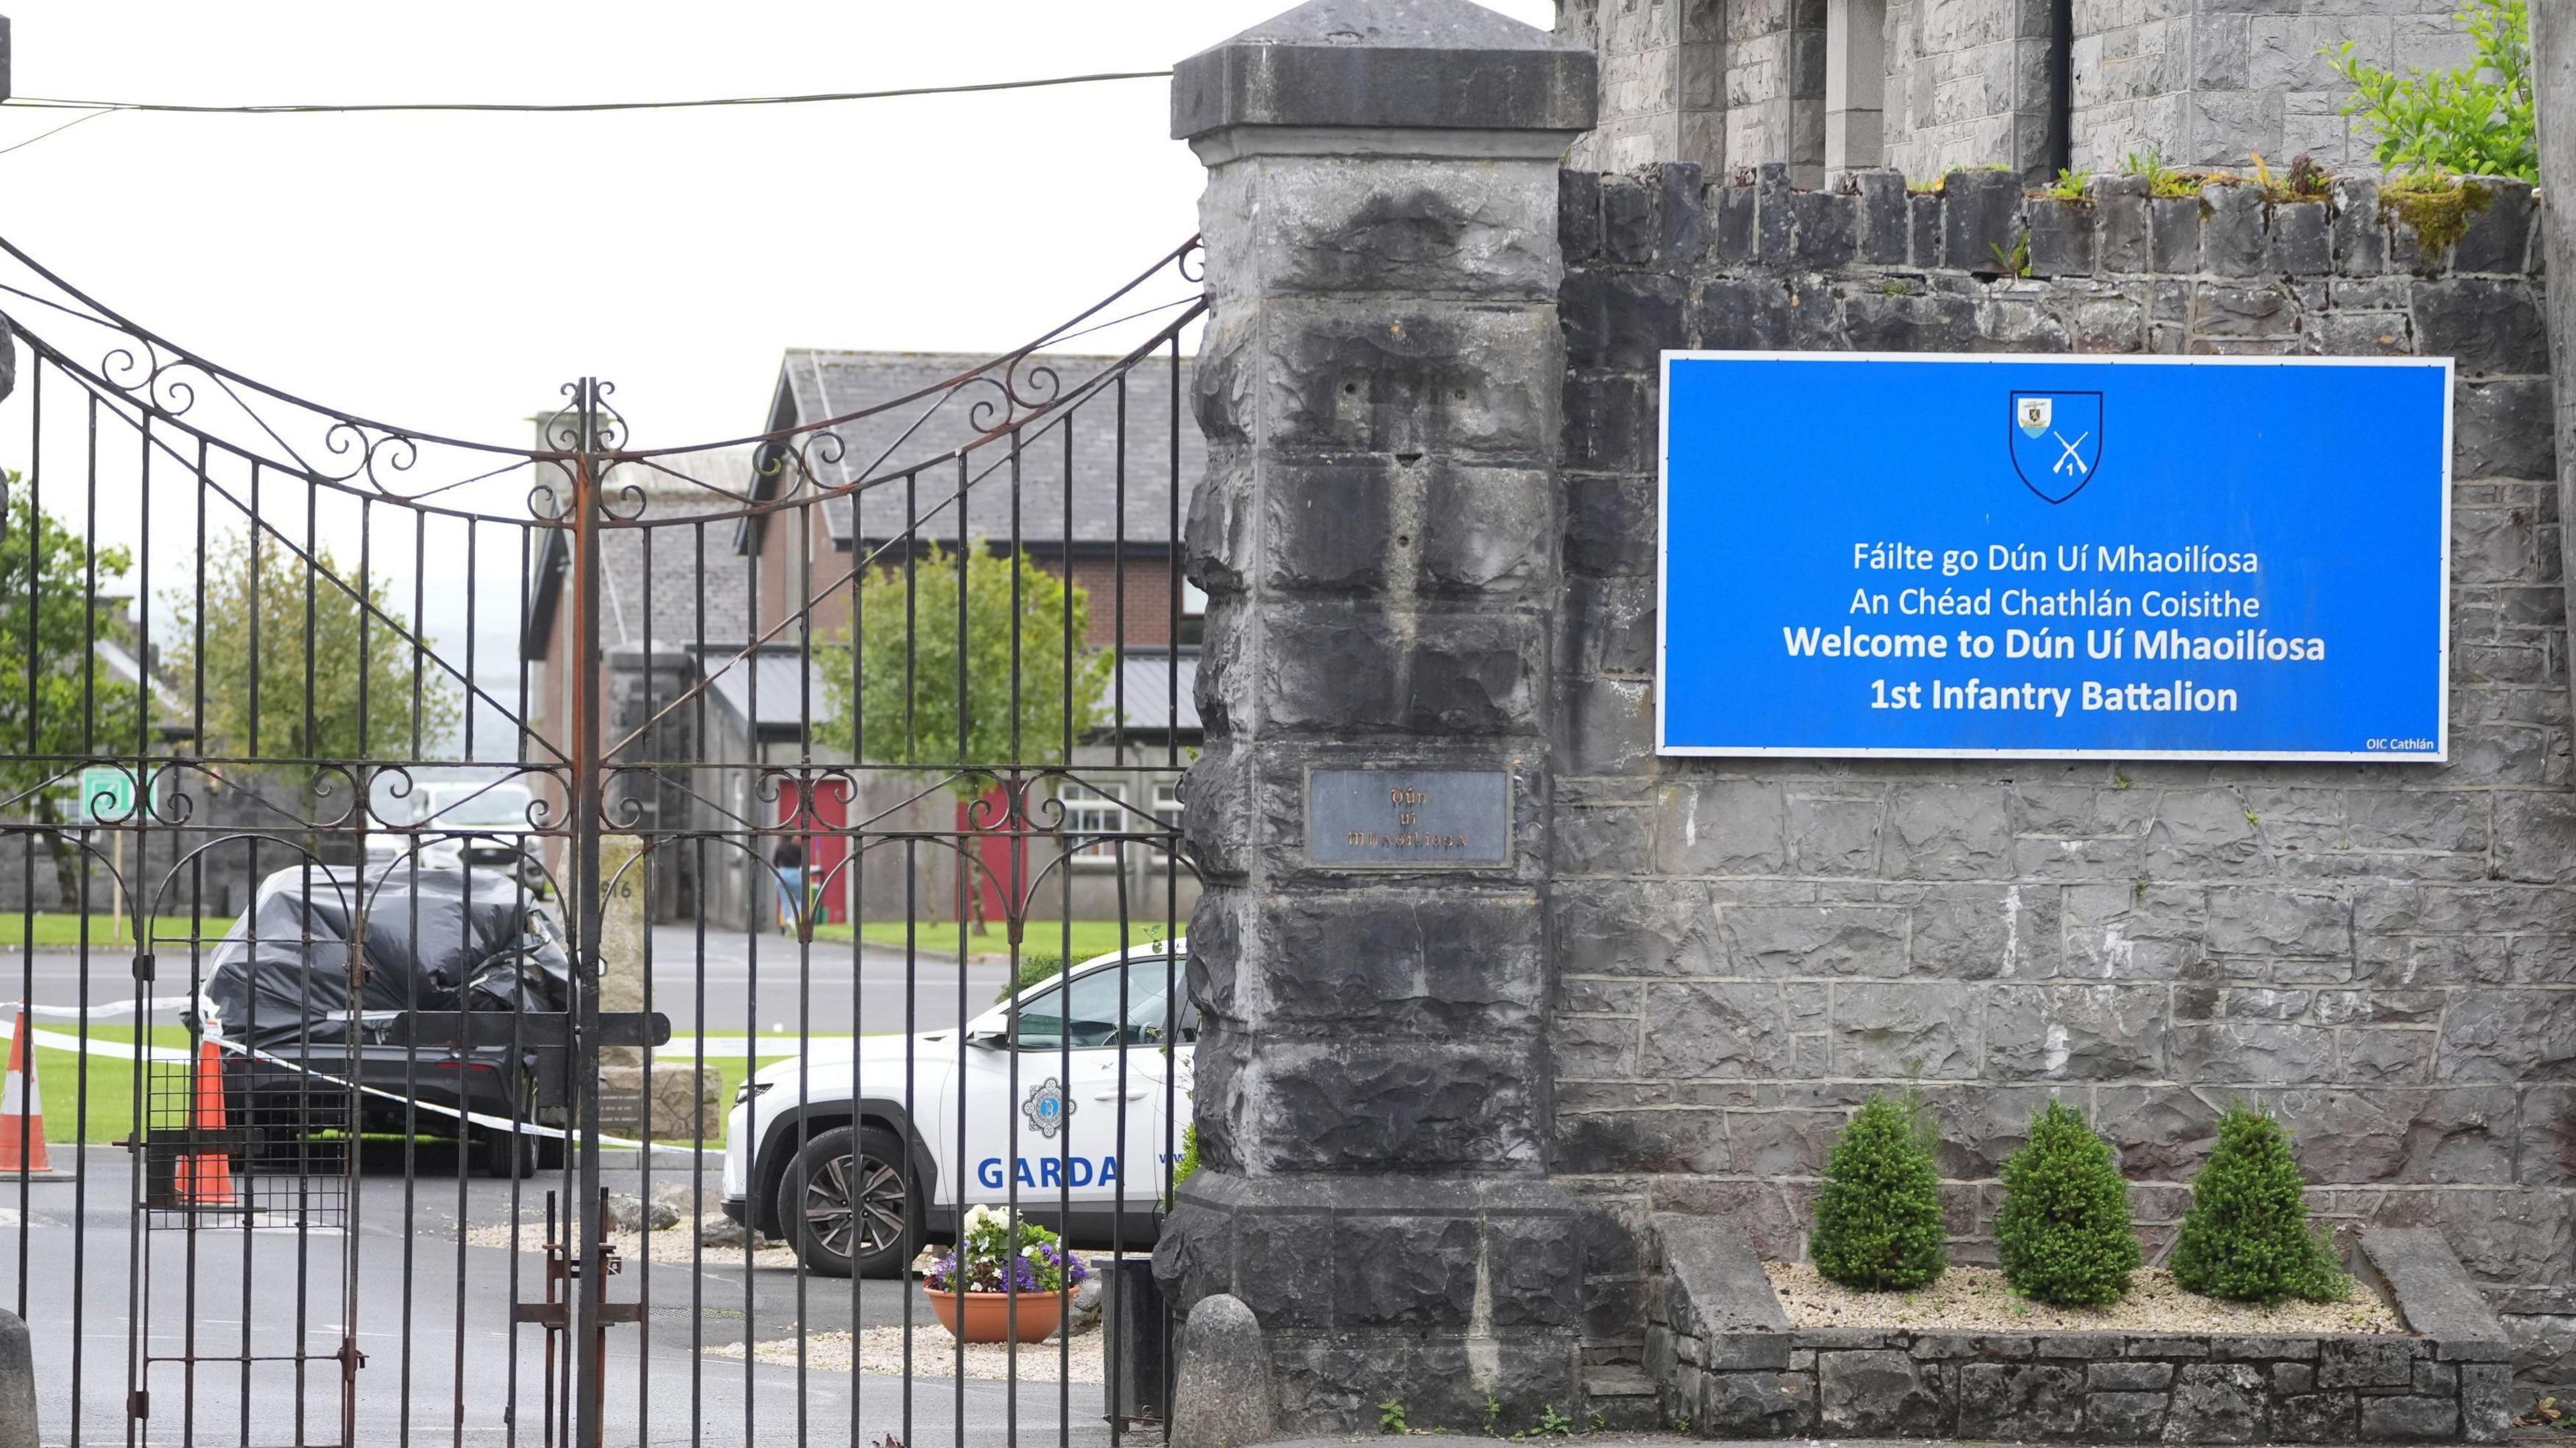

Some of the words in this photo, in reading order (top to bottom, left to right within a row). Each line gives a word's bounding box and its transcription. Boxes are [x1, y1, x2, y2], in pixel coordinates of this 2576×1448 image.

[2066, 462, 2074, 476] 1
[1854, 541, 1933, 571] Fáilte
[1942, 550, 1978, 577] go
[1988, 543, 2047, 572] Dún
[2057, 544, 2089, 572] Uí
[2098, 544, 2258, 574] Mhaoilíosa
[1849, 588, 1889, 615] An
[1899, 587, 1991, 617] Chéad
[2000, 588, 2131, 617] Chathlán
[2141, 590, 2260, 619] Coisithe
[1782, 625, 1948, 659] Welcome
[1957, 630, 1994, 659] to
[2006, 627, 2075, 660] Dún
[2087, 627, 2125, 660] Uí
[2134, 628, 2325, 662] Mhaoilíosa
[1870, 678, 1922, 710] 1st
[1933, 678, 2072, 719] Infantry
[2082, 679, 2237, 713] Battalion
[2366, 738, 2387, 750] OIC
[2390, 738, 2434, 750] Cathlán
[977, 1156, 1125, 1189] GARDA
